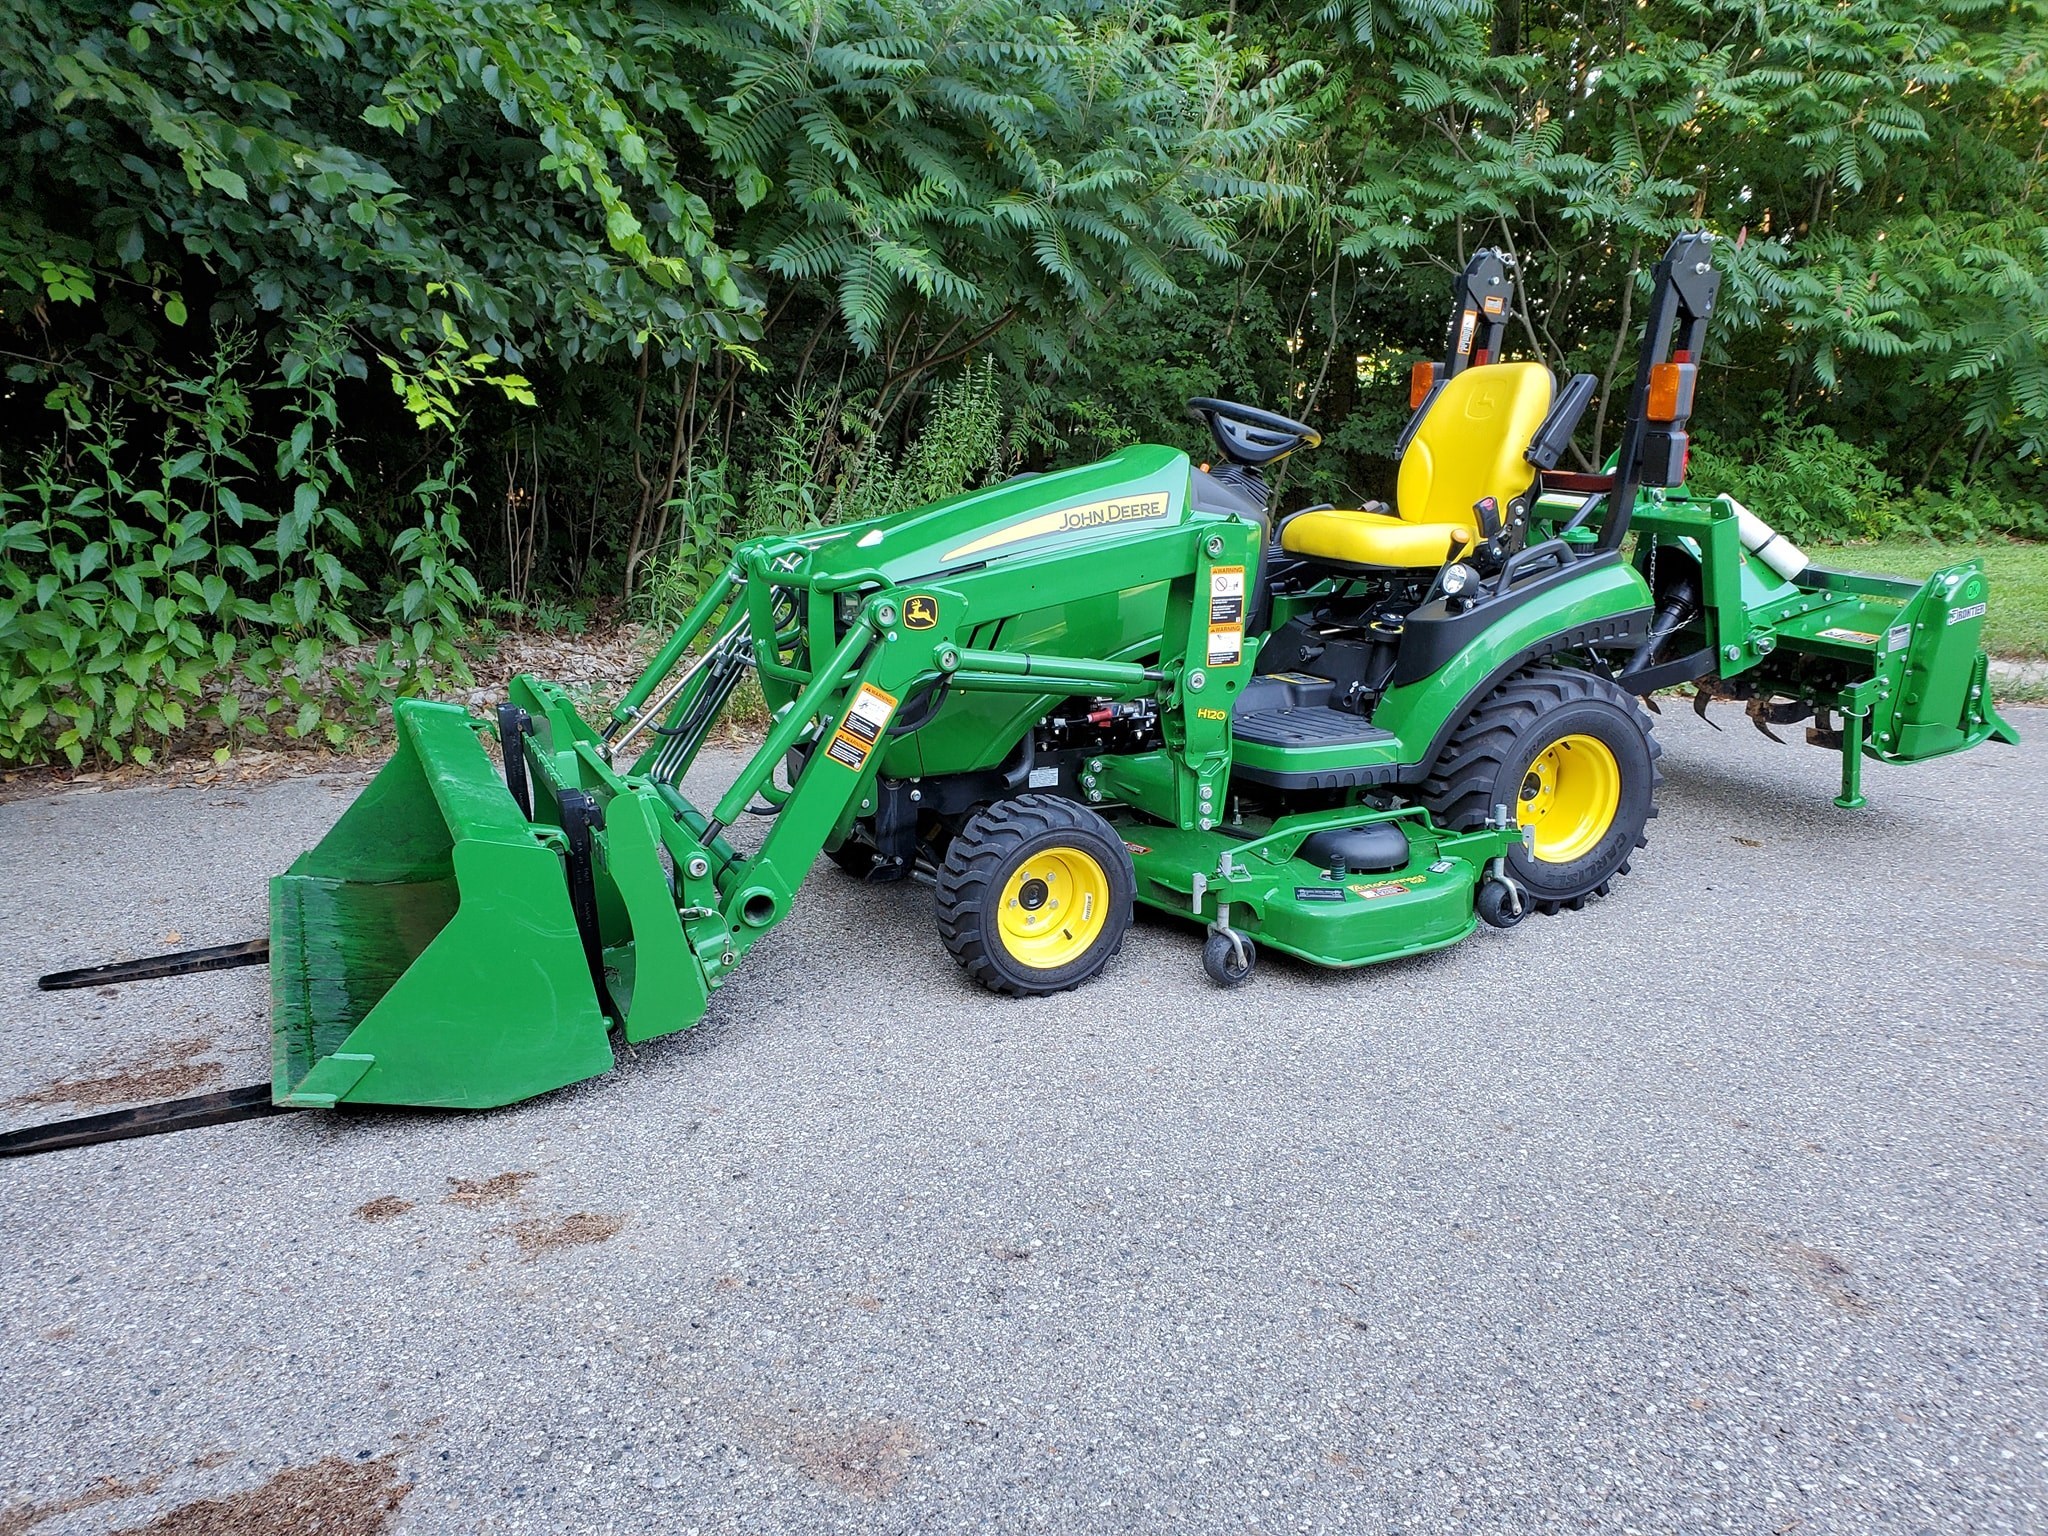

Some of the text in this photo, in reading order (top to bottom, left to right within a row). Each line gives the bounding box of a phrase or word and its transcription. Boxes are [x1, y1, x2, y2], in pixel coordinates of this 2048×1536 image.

[1059, 502, 1160, 529] JOHN DEERE
[871, 688, 893, 704] WARNING
[1197, 708, 1226, 720] H120
[846, 736, 867, 751] WARNING
[1543, 832, 1628, 887] CARLISLE
